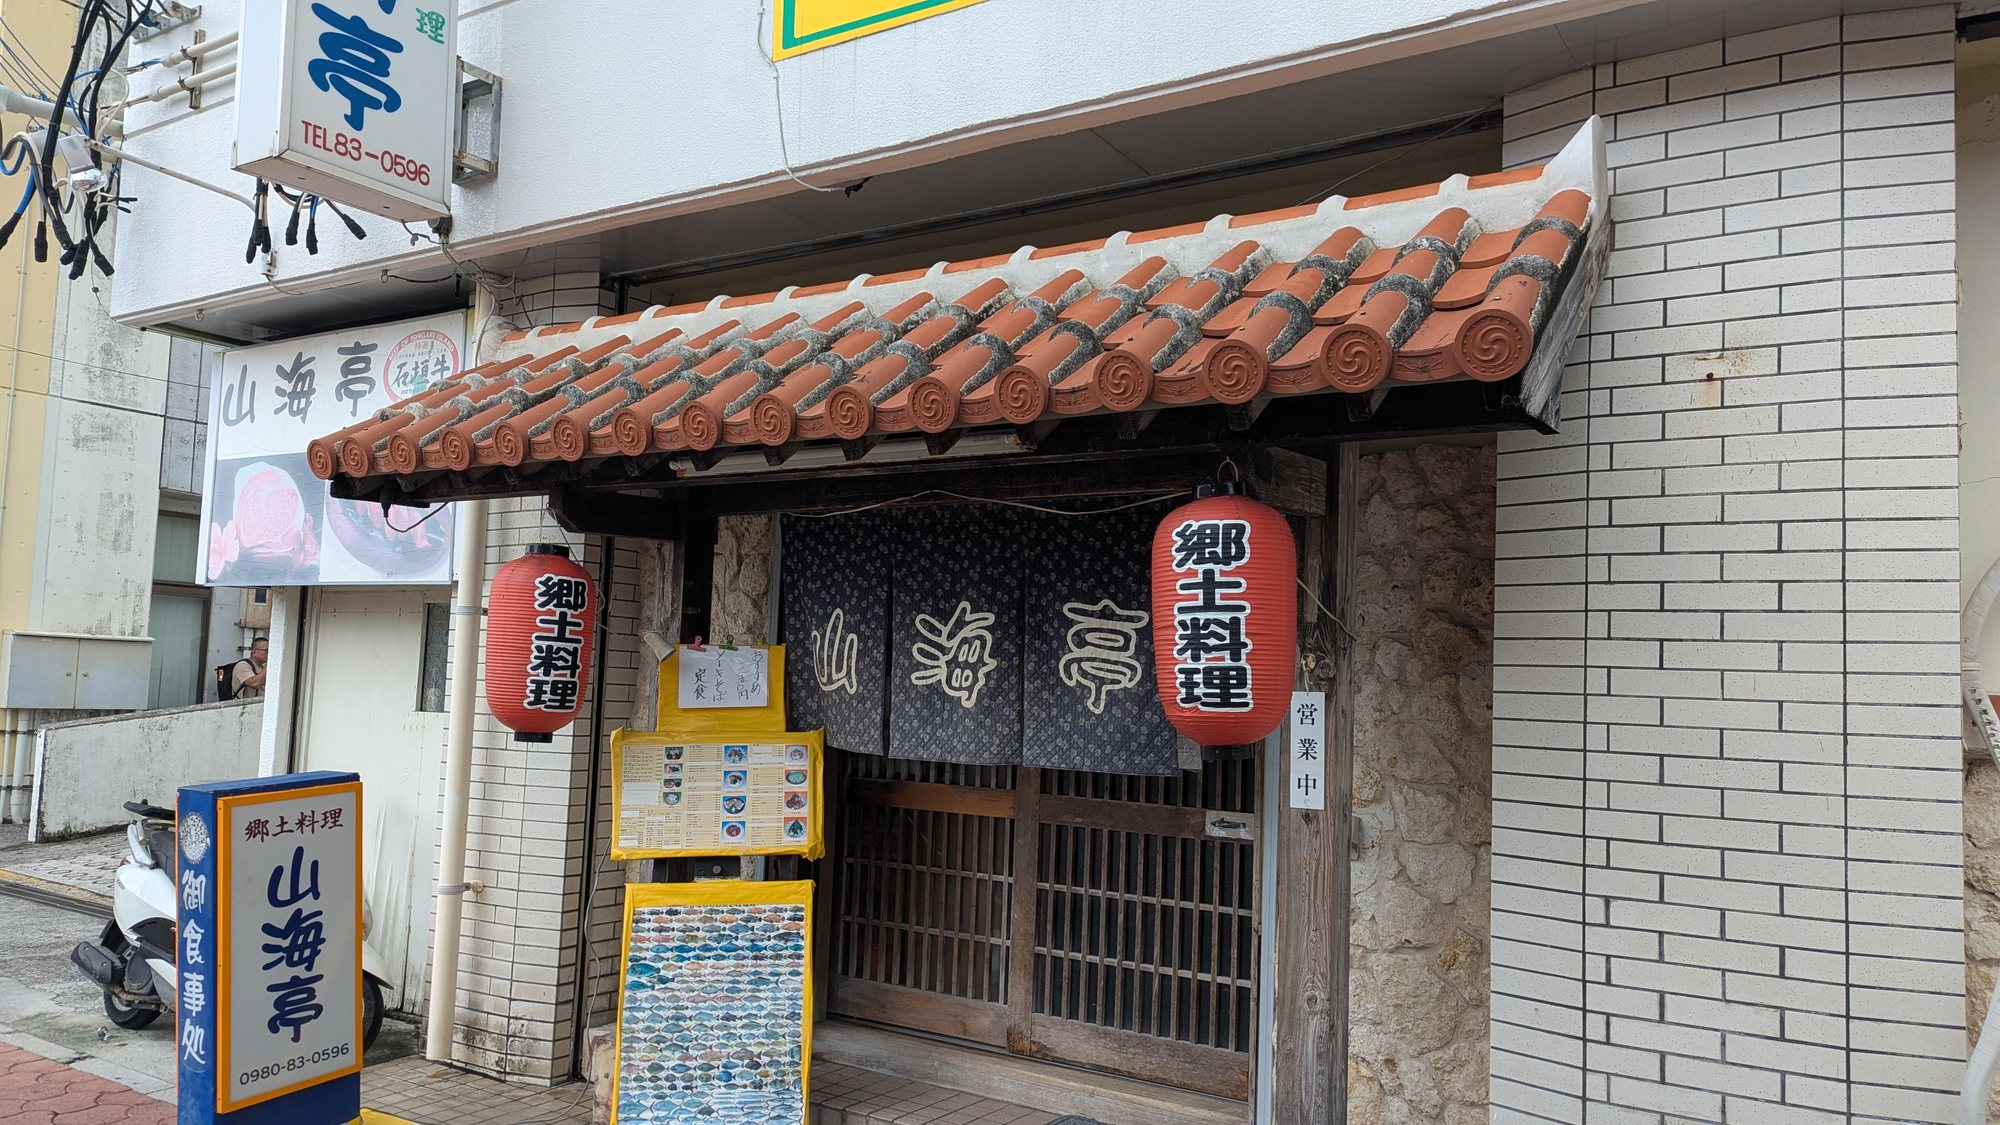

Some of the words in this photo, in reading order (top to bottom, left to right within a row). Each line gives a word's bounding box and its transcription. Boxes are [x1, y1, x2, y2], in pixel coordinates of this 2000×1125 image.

[307, 0, 404, 131] 亭
[223, 341, 379, 427] 山海亭
[391, 353, 451, 389] 石垣牛
[401, 337, 410, 347] OF
[410, 331, 436, 342] ISHIGAKI
[436, 332, 455, 352] ISLAND
[525, 574, 588, 711] 郷土料理
[811, 600, 1150, 714] 山海亭
[1173, 521, 1252, 711] 郷土料理
[693, 667, 710, 700] 定食
[1296, 702, 1319, 797] 営業中
[245, 808, 344, 843] 郷土料理
[181, 869, 206, 1065] 御食事処
[261, 845, 326, 1044] 山海亭
[239, 1043, 350, 1086] 0980-83-0596
